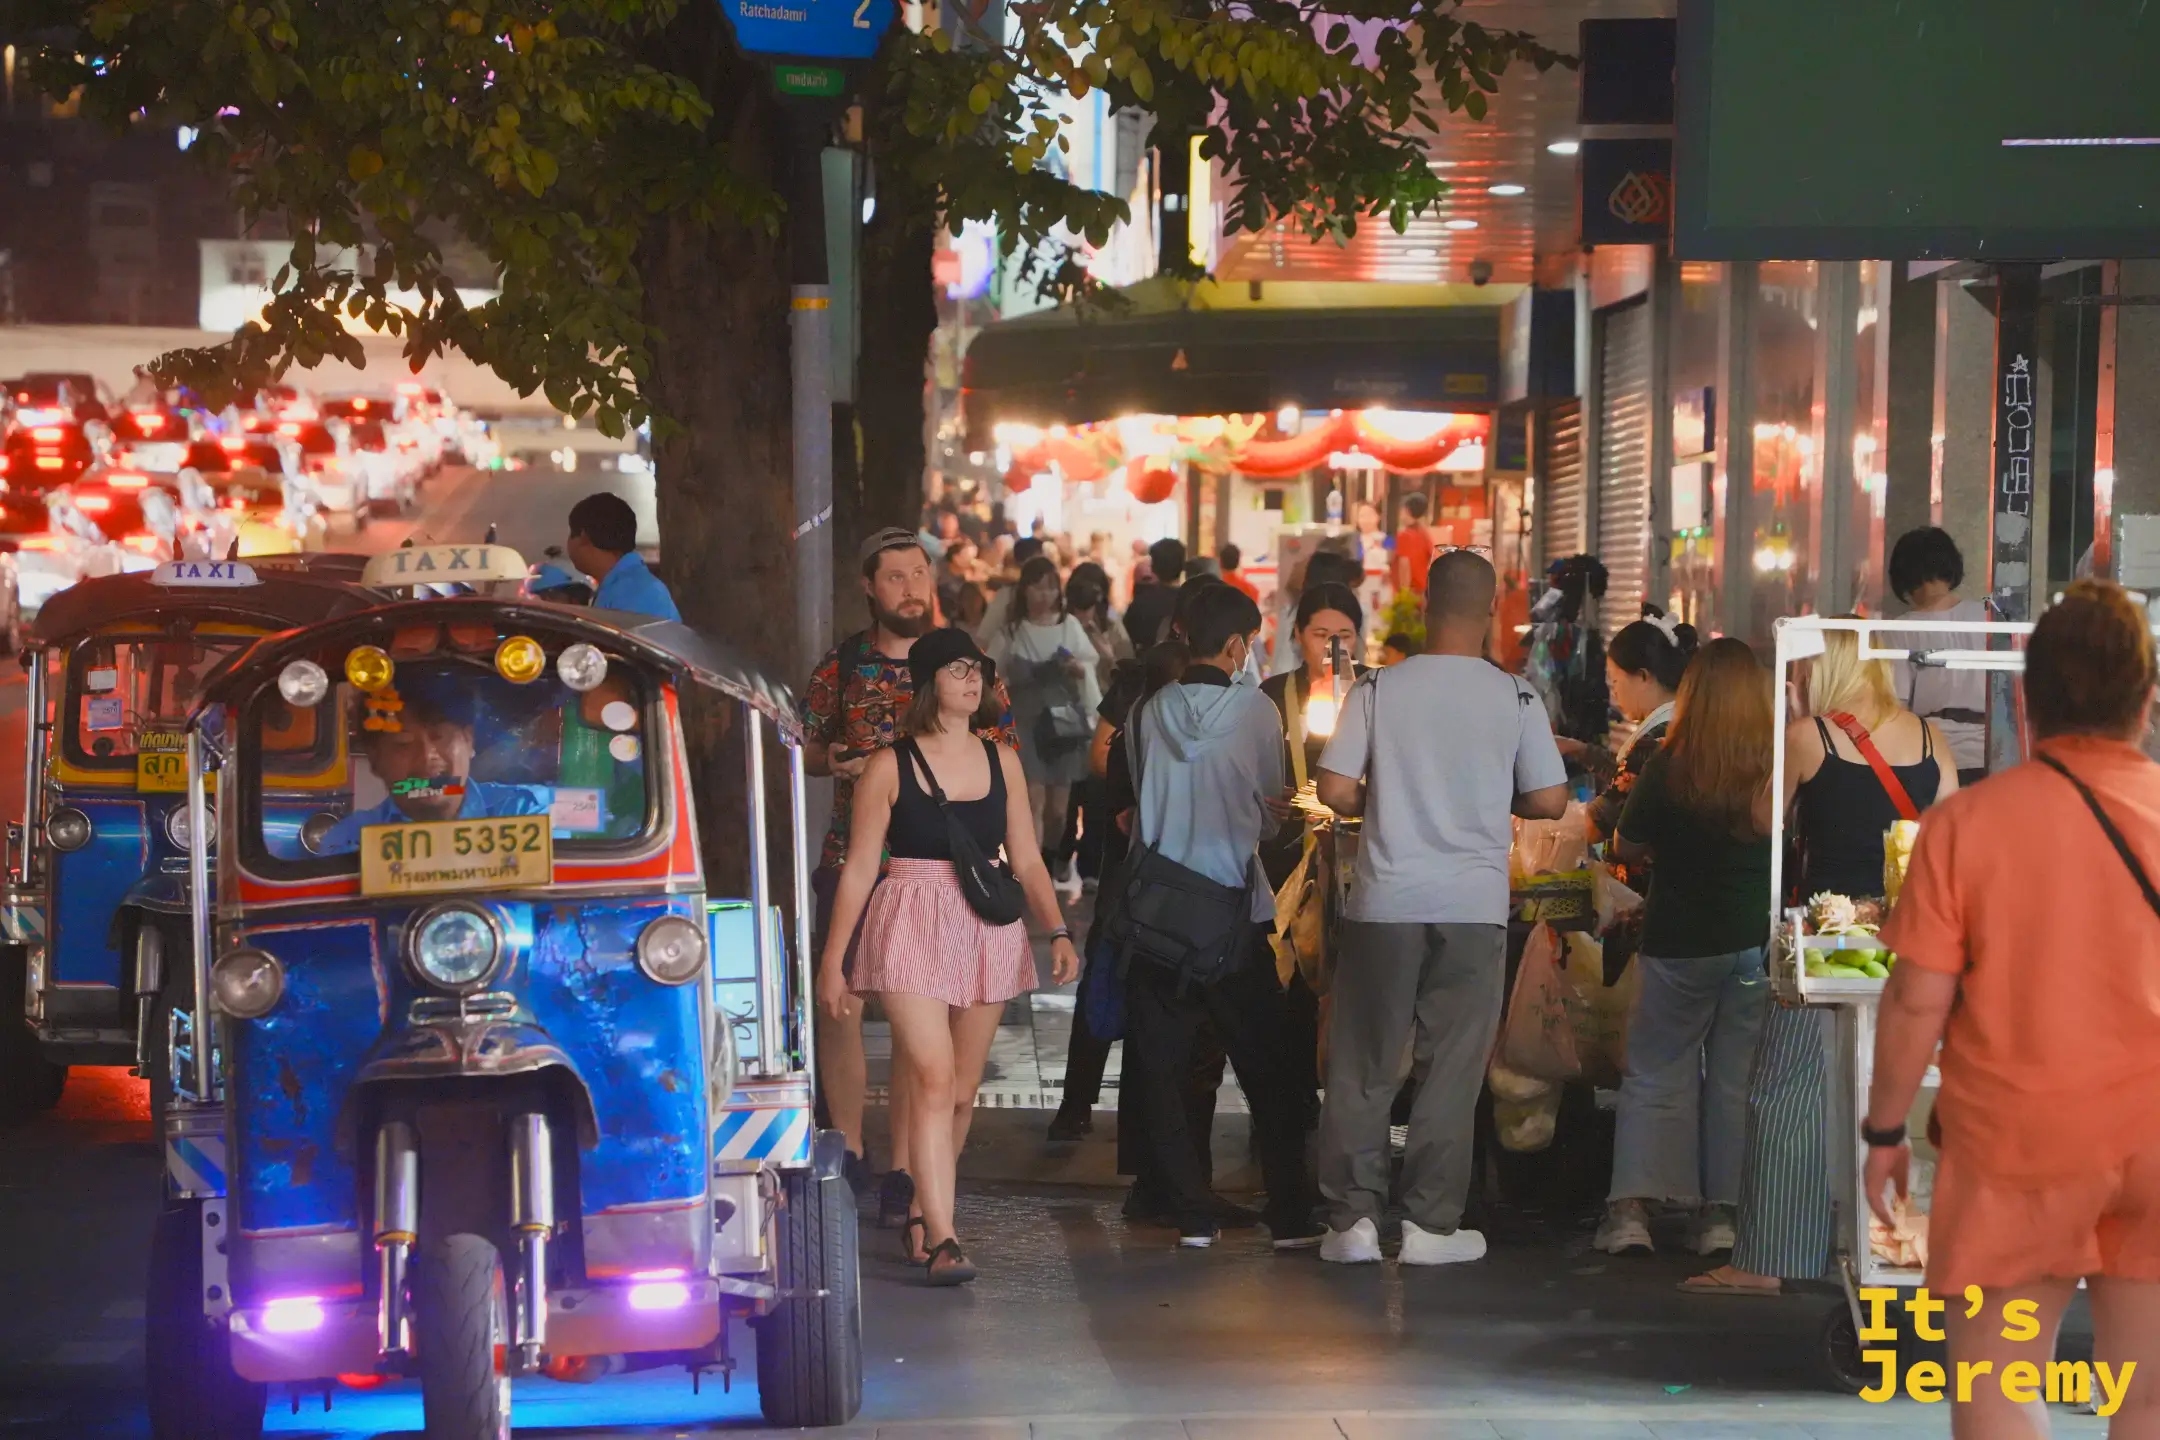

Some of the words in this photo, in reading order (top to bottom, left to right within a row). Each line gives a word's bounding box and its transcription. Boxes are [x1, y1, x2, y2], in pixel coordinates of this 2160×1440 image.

[740, 2, 807, 21] Ratchadamri
[853, 0, 870, 28] 2
[172, 563, 235, 579] TAXI
[390, 548, 489, 574] TAXI
[144, 755, 180, 775] สก
[380, 829, 432, 861] สก
[453, 822, 541, 855] 5352
